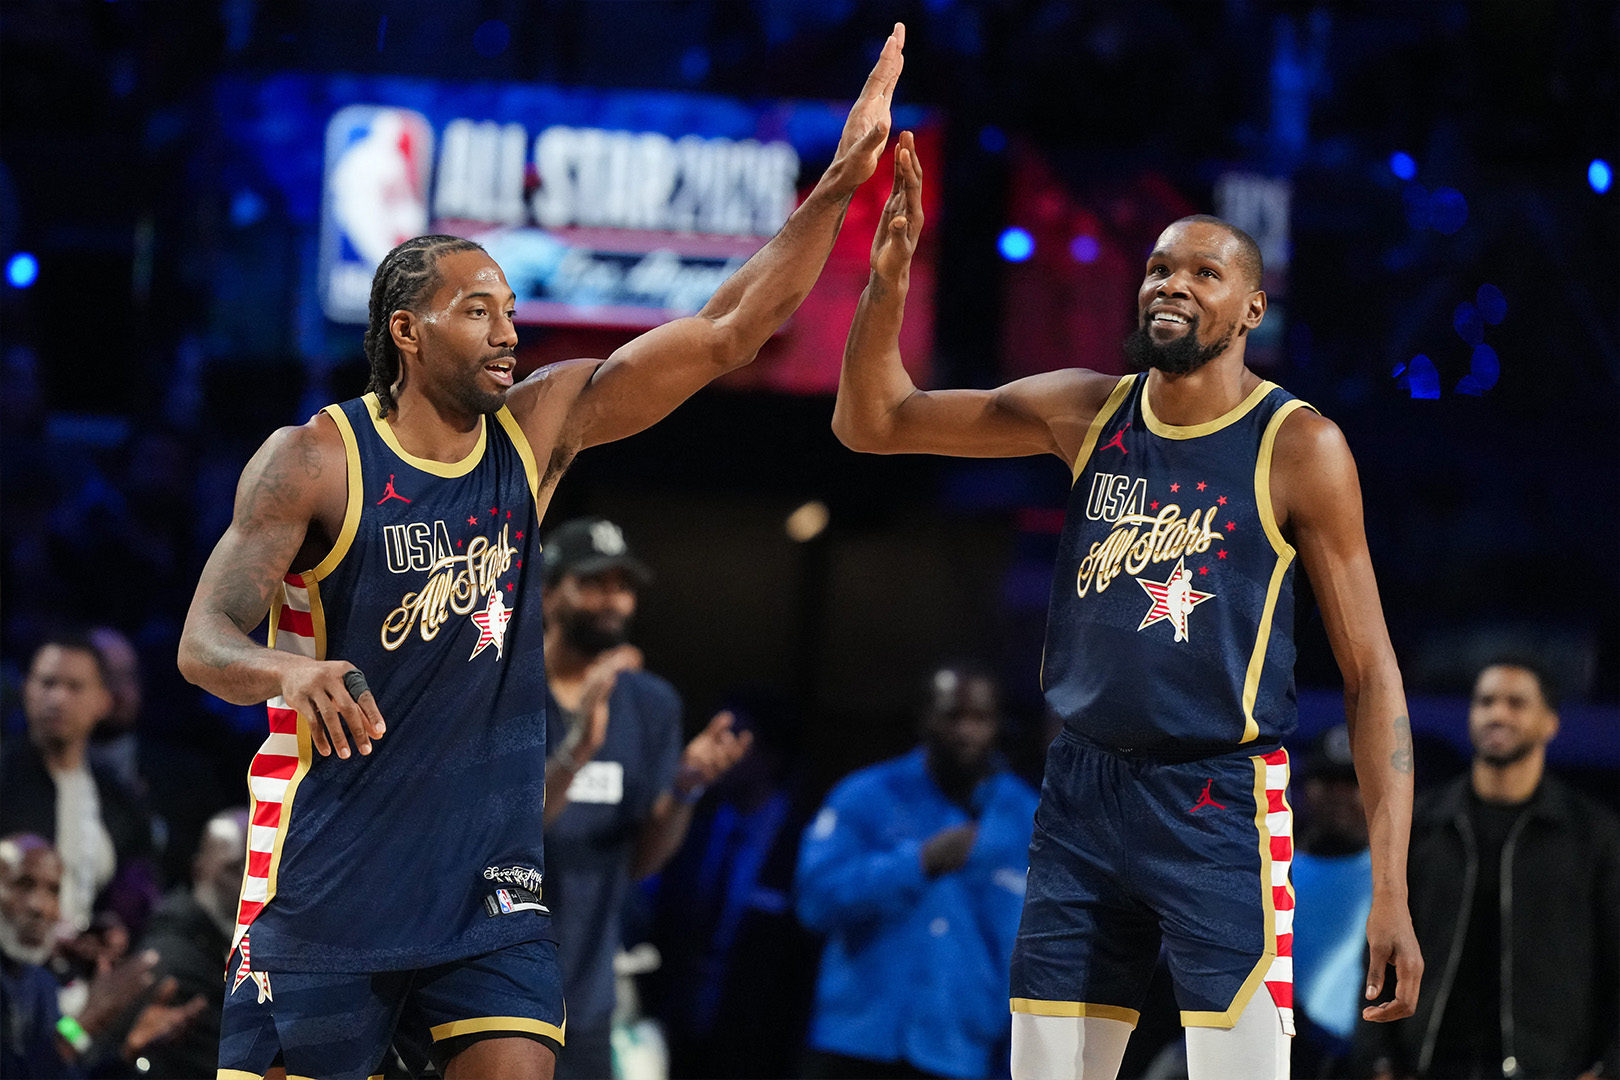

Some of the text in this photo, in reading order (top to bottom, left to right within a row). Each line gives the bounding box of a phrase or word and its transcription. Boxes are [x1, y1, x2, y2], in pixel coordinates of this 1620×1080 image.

[435, 119, 527, 223] ALL
[1086, 472, 1147, 526] USA
[383, 520, 455, 574] USA
[1076, 504, 1224, 599] All Stars
[381, 568, 454, 651] All
